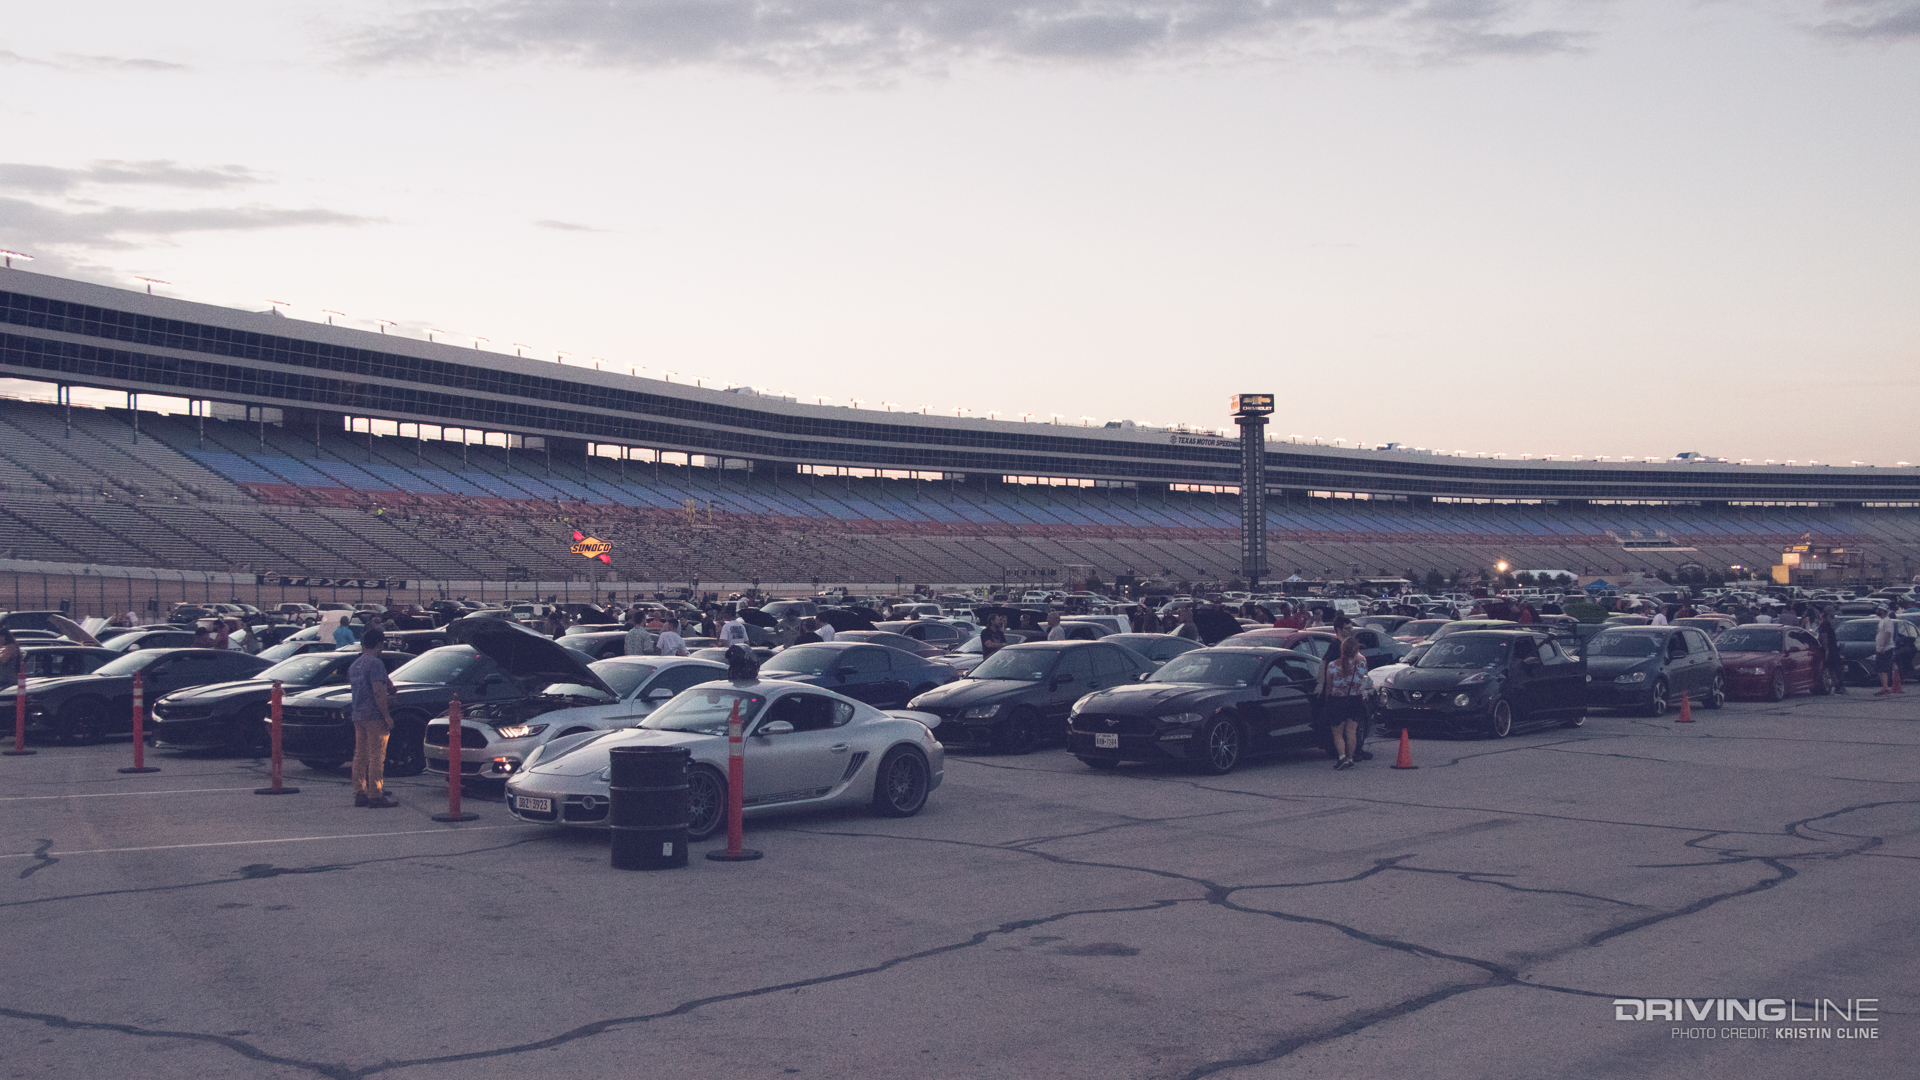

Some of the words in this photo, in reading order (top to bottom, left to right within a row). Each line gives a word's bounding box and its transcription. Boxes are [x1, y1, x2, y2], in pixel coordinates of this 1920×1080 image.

[1197, 438, 1216, 446] MOTOR
[572, 543, 611, 552] SUNOCO
[288, 577, 380, 588] TEXAS
